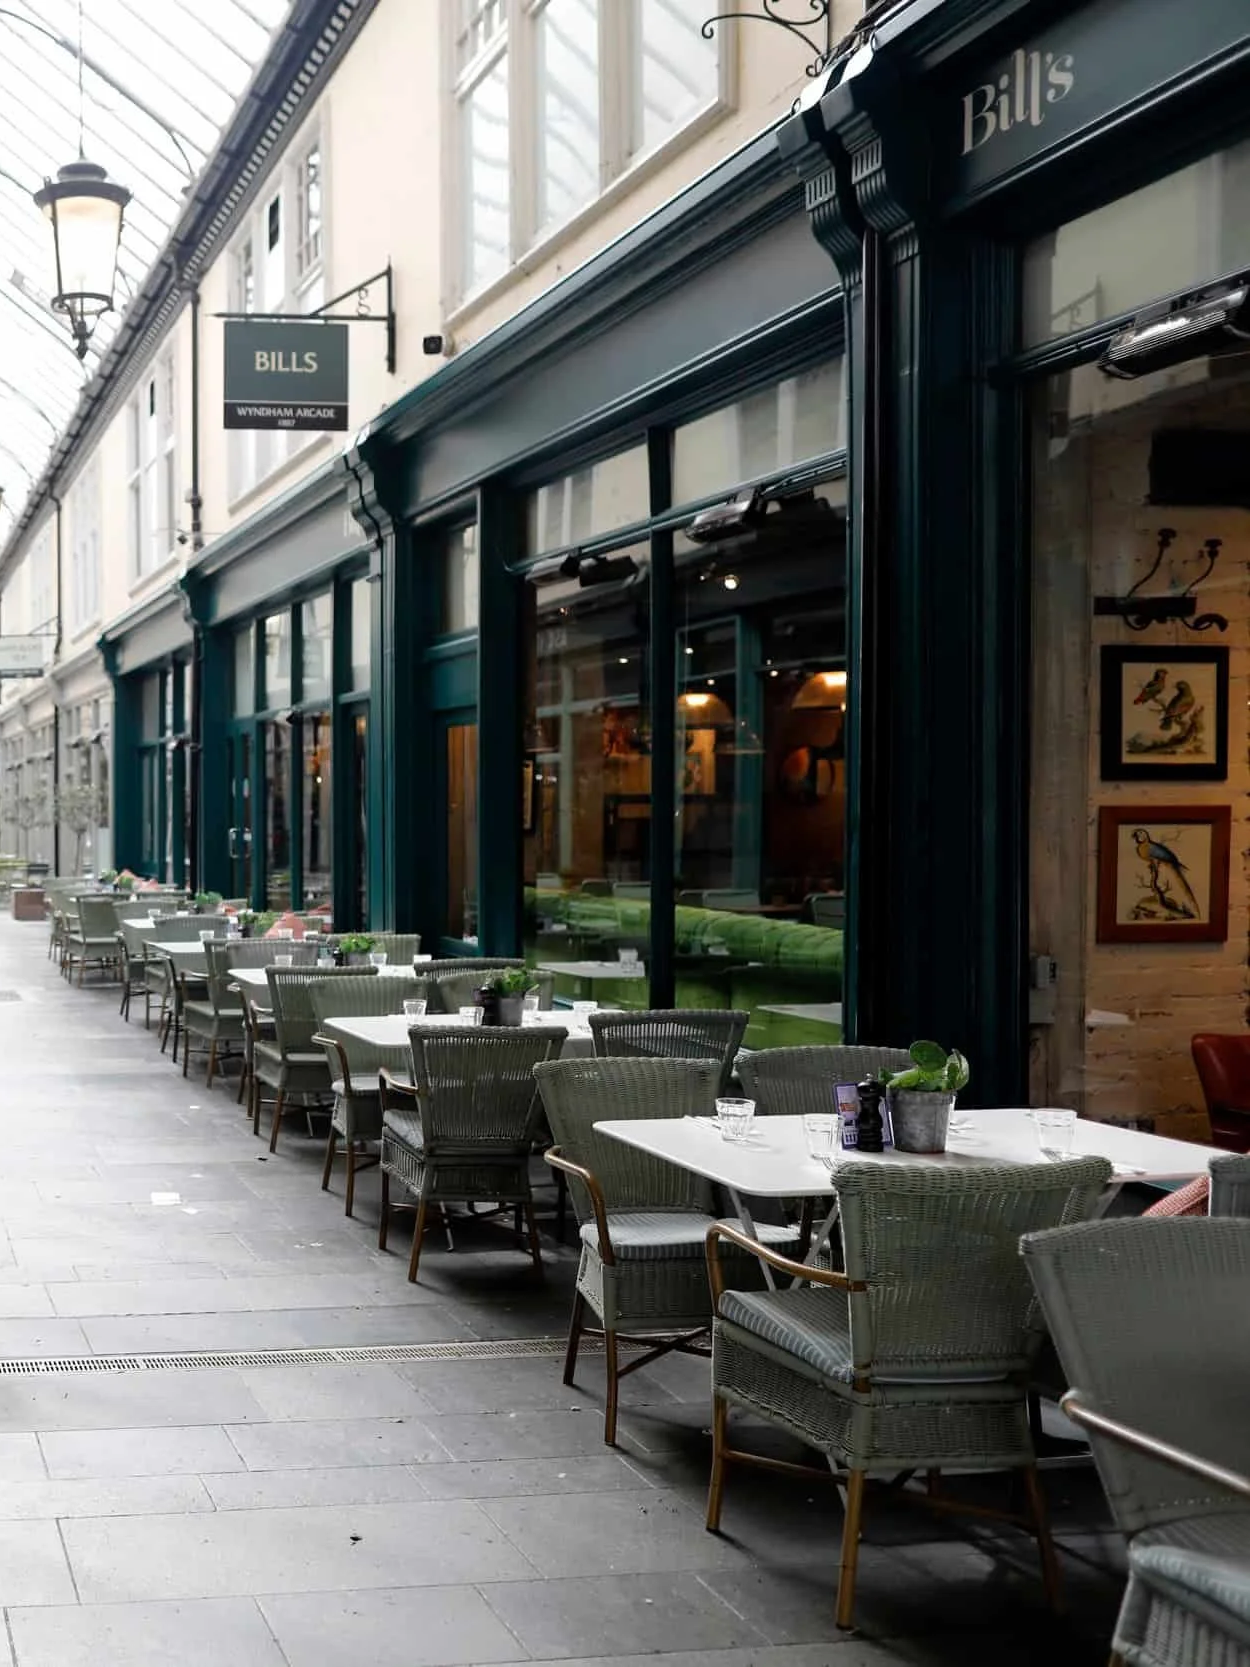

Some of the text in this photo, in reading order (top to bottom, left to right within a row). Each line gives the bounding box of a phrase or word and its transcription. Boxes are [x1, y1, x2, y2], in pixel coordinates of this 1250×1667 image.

[962, 48, 1074, 155] Bill's
[254, 351, 318, 373] BILLS
[236, 407, 336, 419] WYNDHAM ARCADE
